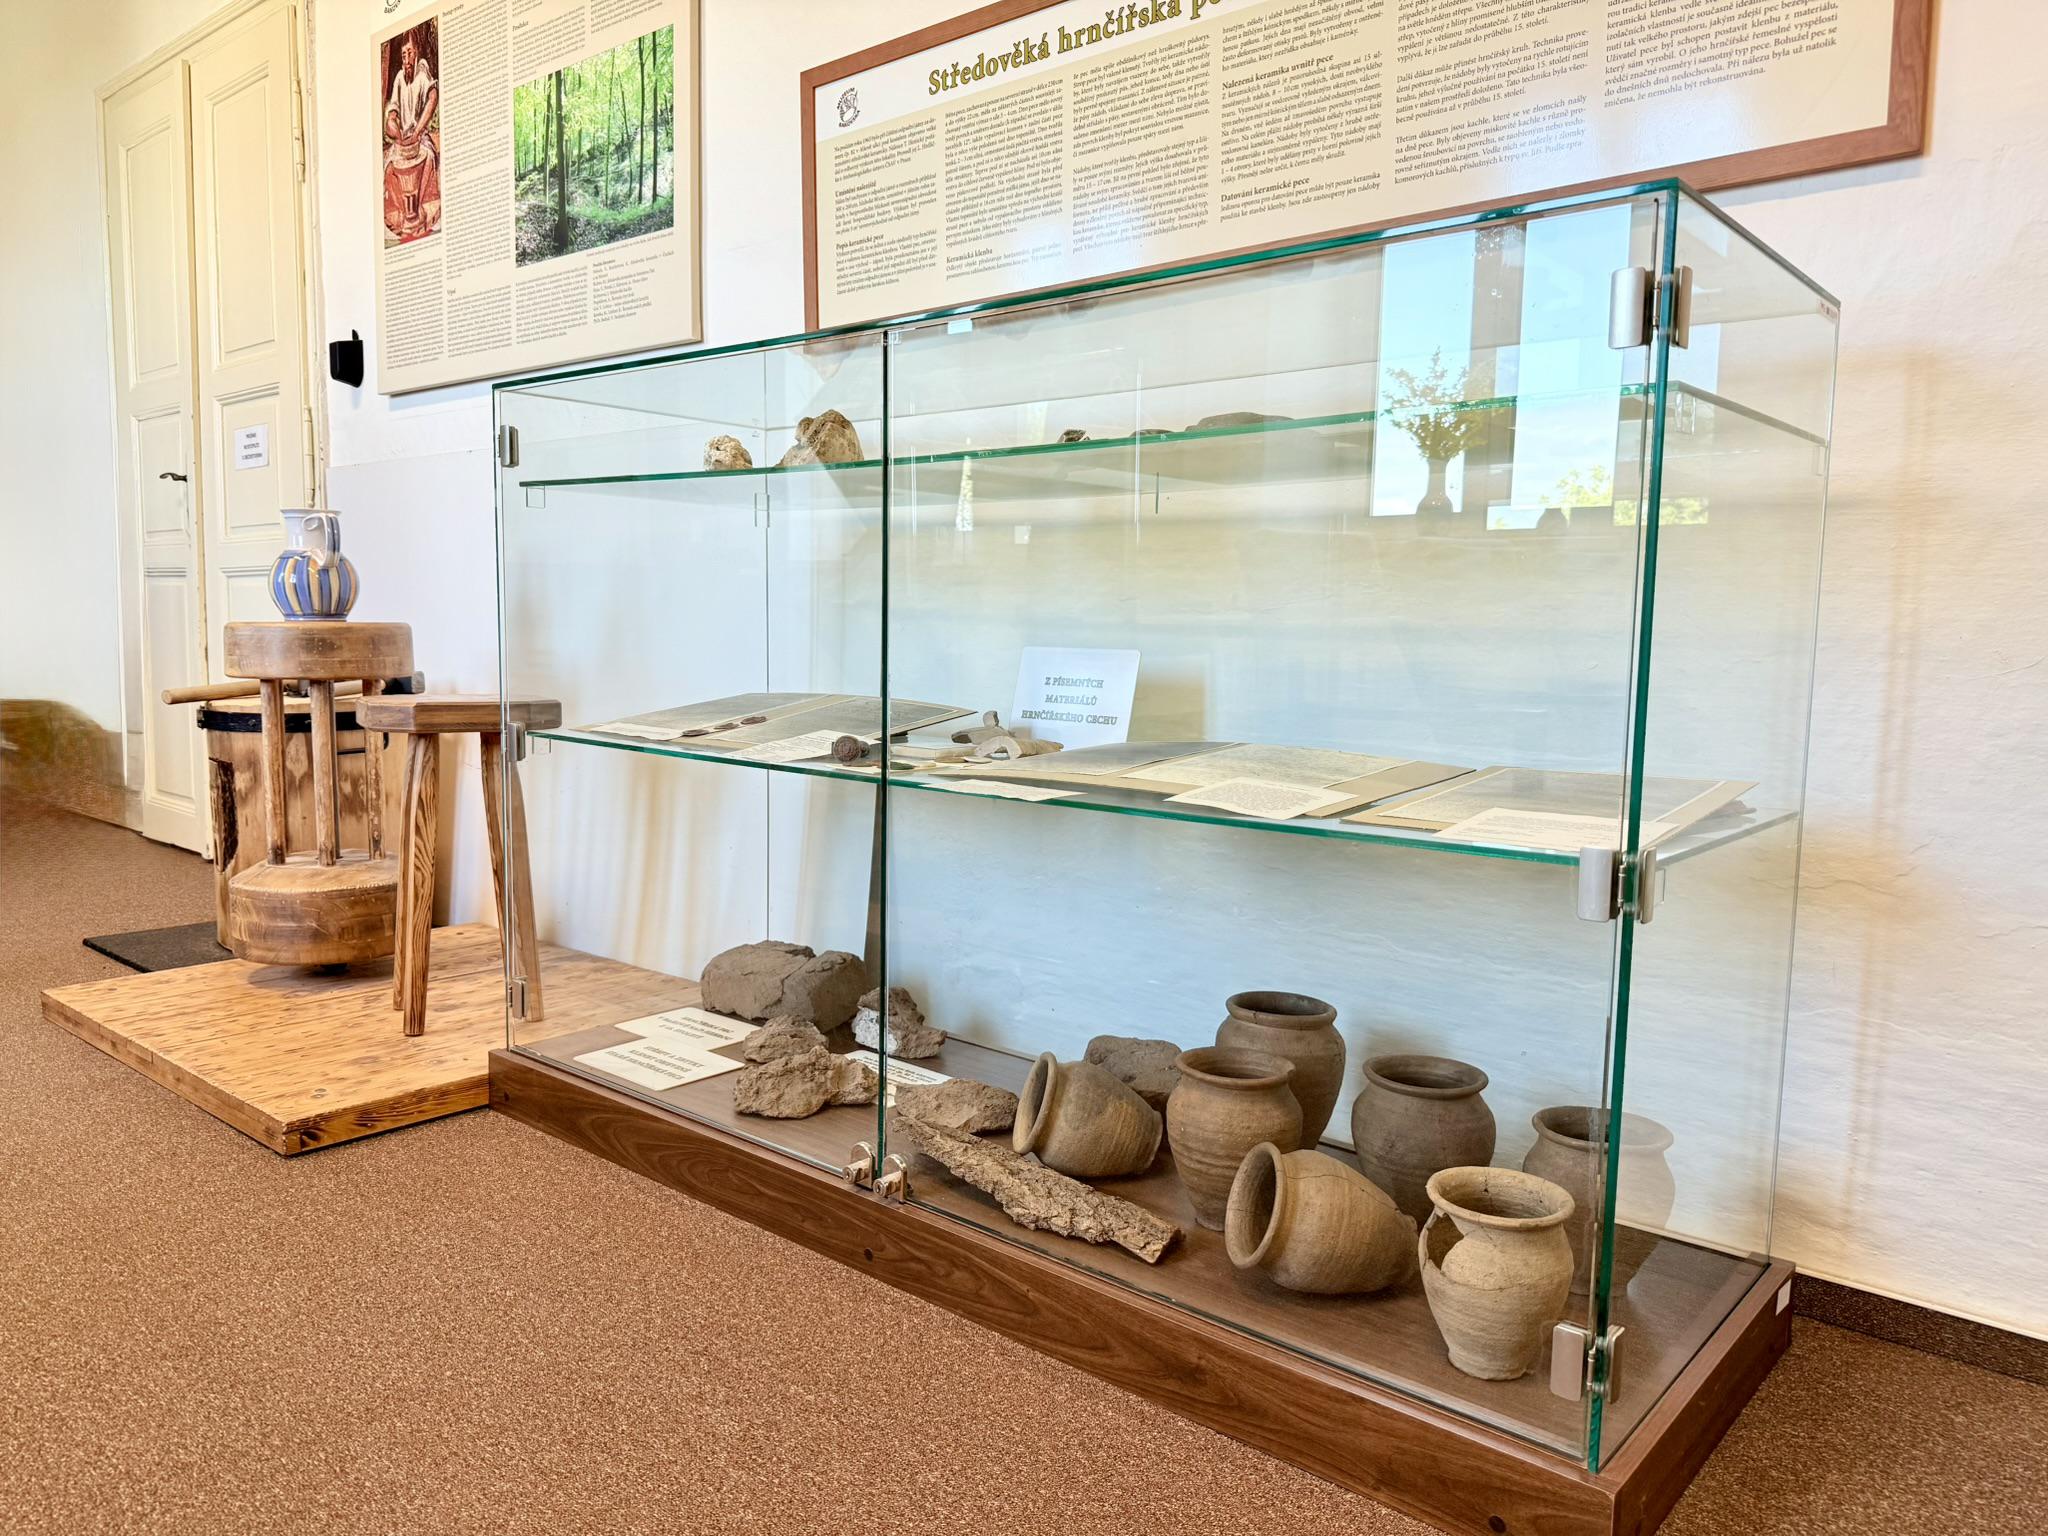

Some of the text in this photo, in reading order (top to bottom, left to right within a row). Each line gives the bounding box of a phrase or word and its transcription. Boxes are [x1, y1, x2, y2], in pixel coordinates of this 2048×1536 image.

[1426, 35, 1432, 46] je
[1521, 8, 1534, 18] této
[1606, 24, 1645, 40] izolačních
[1647, 14, 1685, 30] vlastností
[1687, 12, 1694, 22] je
[1696, 2, 1733, 18] současně
[1607, 12, 1646, 29] keramická
[1650, 5, 1676, 18] klenba
[1624, 38, 1635, 47] tak
[1638, 30, 1668, 44] velkého
[1709, 14, 1734, 28] jakým
[1737, 7, 1761, 22] zdejší
[1764, 5, 1778, 15] pec
[1473, 33, 1482, 42] do
[1532, 34, 1563, 48] Technika
[1605, 13, 1837, 76] který sám vyrobil. O jeho hrnčířské řemeslné vyspělosti
[1606, 49, 1636, 62] Uživatel
[1640, 46, 1657, 56] pece
[1661, 40, 1673, 51] byl
[1677, 31, 1710, 48] schopen
[1714, 22, 1747, 39] postavit
[1751, 14, 1780, 28] klenbu
[929, 32, 1050, 96] Středověká
[1549, 54, 1570, 66] století
[1572, 49, 1588, 60] není
[1630, 66, 1656, 79] značné
[1658, 58, 1692, 74] rozměry
[1698, 49, 1733, 65] samotný
[1735, 45, 1748, 57] typ
[1750, 42, 1771, 53] pece.
[1774, 32, 1808, 46] Bohužel
[1810, 29, 1825, 40] pec
[1222, 54, 1334, 90] Nalezená keramika uvnitř pece
[1396, 83, 1409, 93] dení
[1451, 66, 1475, 81] nádoby
[1476, 63, 1490, 75] byly
[1491, 55, 1521, 71] vytočeny
[1533, 47, 1554, 60] rychle
[1504, 77, 1520, 87] Tato
[1522, 70, 1550, 83] technika
[1552, 66, 1567, 78] byla
[1604, 87, 1614, 96] do
[1616, 79, 1651, 93] dnešních
[1653, 75, 1669, 85] dnů
[1727, 59, 1739, 68] Při
[1742, 53, 1769, 65] nálezu
[1771, 48, 1790, 61] byla
[1792, 45, 1802, 54] už
[1805, 38, 1836, 51] natolik
[1637, 92, 1645, 100] že
[1647, 84, 1682, 98] nemohla
[1684, 80, 1696, 92] být
[1221, 178, 1310, 202] Datování keramické pece
[975, 248, 992, 257] klenba
[1044, 676, 1104, 689] Z PÍSEMNÝCH
[1045, 694, 1098, 706] MATERIÁLŮ
[1021, 710, 1118, 725] HRNČÍŘSKÉHO CECHU
